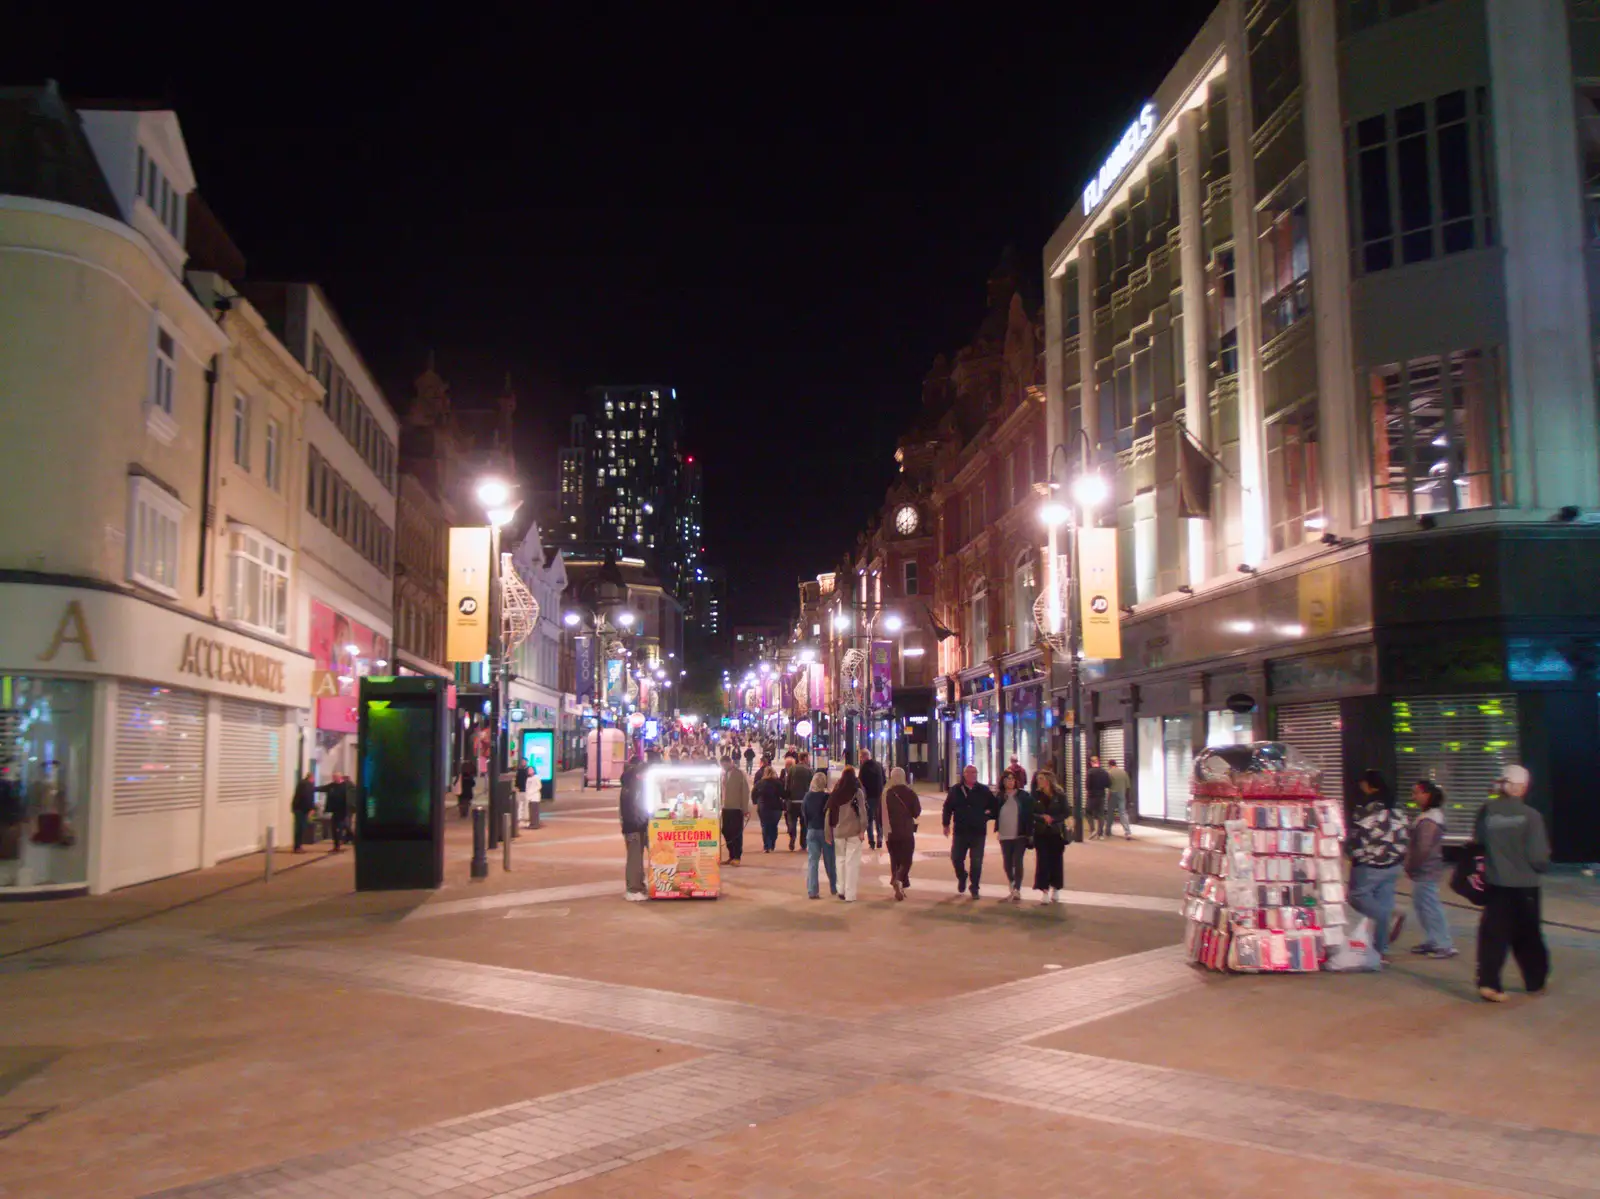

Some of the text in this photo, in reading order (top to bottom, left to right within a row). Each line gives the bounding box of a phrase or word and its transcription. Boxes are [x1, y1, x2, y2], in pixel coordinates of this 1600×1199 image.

[38, 600, 97, 662] A
[316, 673, 337, 696] A
[657, 830, 712, 841] SWEETCORN
